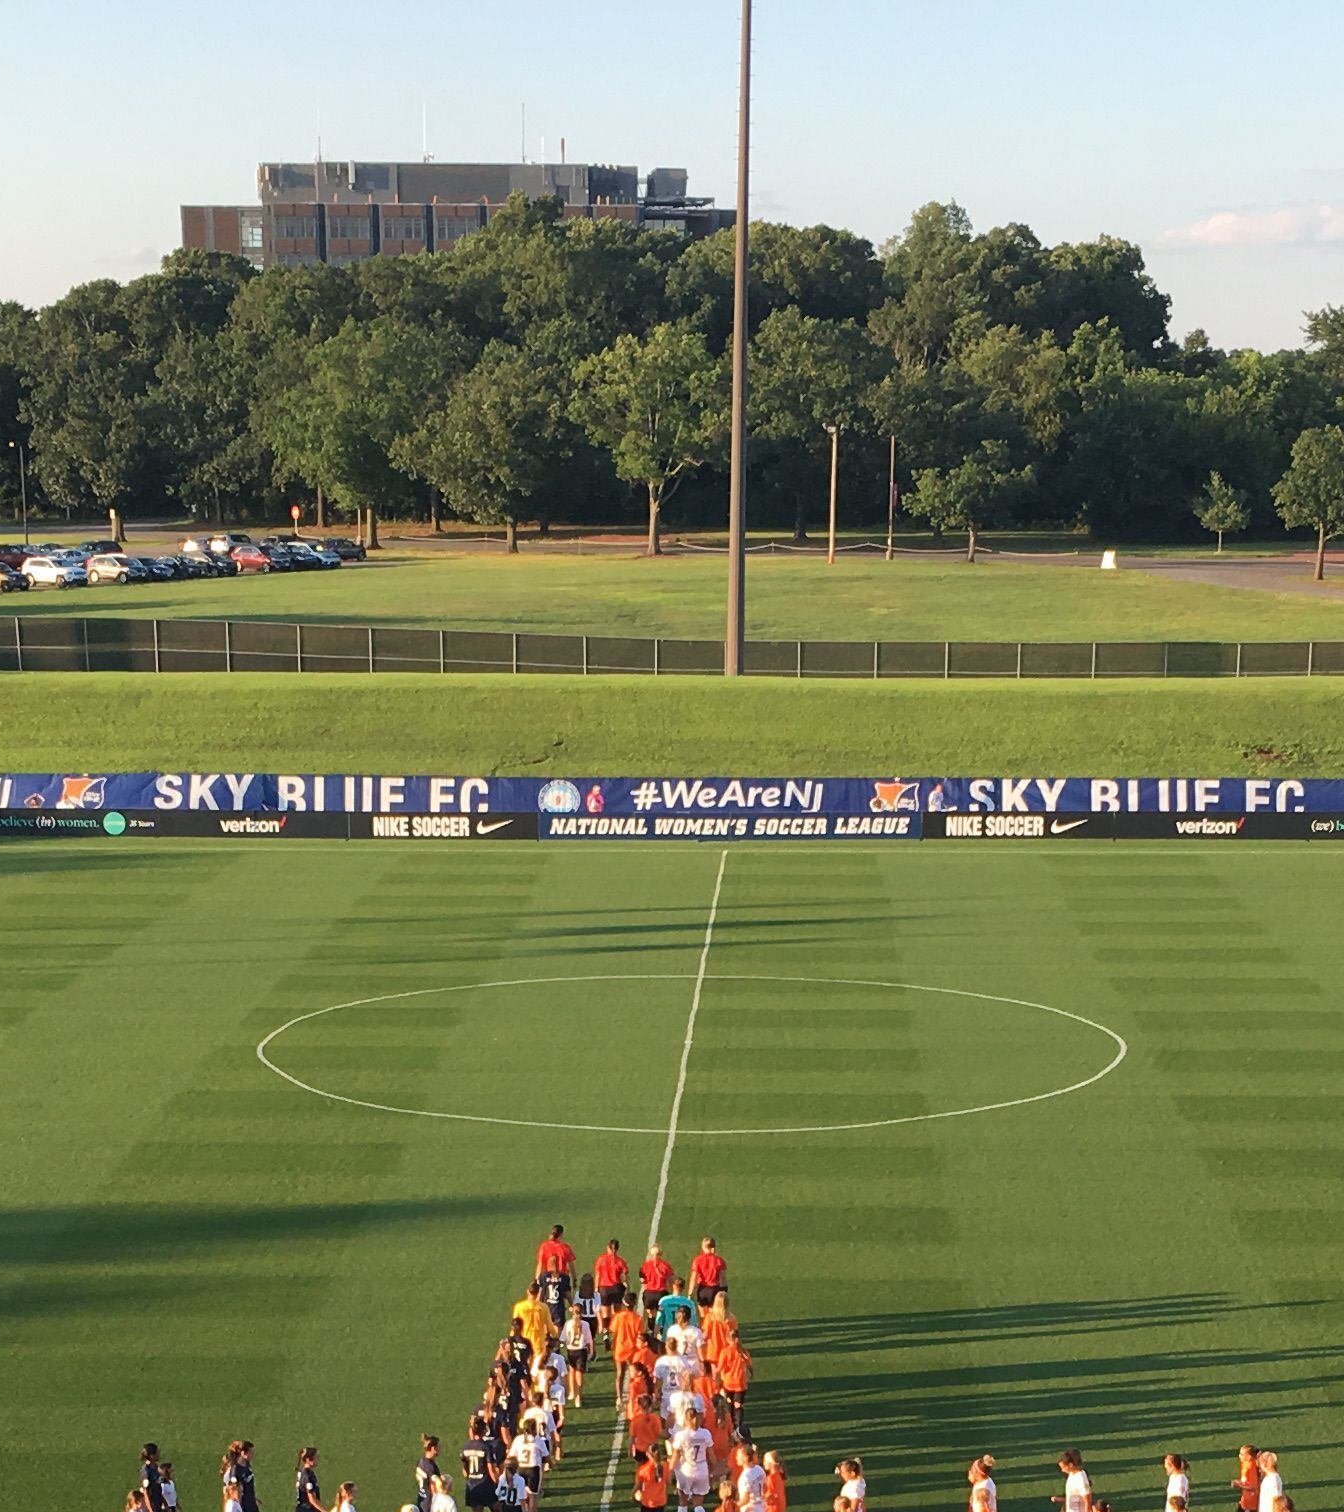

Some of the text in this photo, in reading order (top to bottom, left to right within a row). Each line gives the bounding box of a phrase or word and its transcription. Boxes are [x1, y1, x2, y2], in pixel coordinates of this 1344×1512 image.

[154, 774, 254, 811] SKY
[429, 777, 489, 813] FC
[630, 780, 823, 813] #WeAreNJ
[969, 779, 1066, 812] SKY
[1245, 780, 1305, 813] FC
[35, 816, 56, 829] (in)
[57, 819, 100, 828] women.
[219, 817, 281, 834] verizon
[372, 816, 470, 837] NIKE SOCCER
[550, 817, 911, 836] NATIONAL WOMEN'S SOCCER LEAGUE
[945, 815, 1044, 836] NIKE SOCCER
[1175, 819, 1238, 834] verizon
[1311, 820, 1335, 833] (we)
